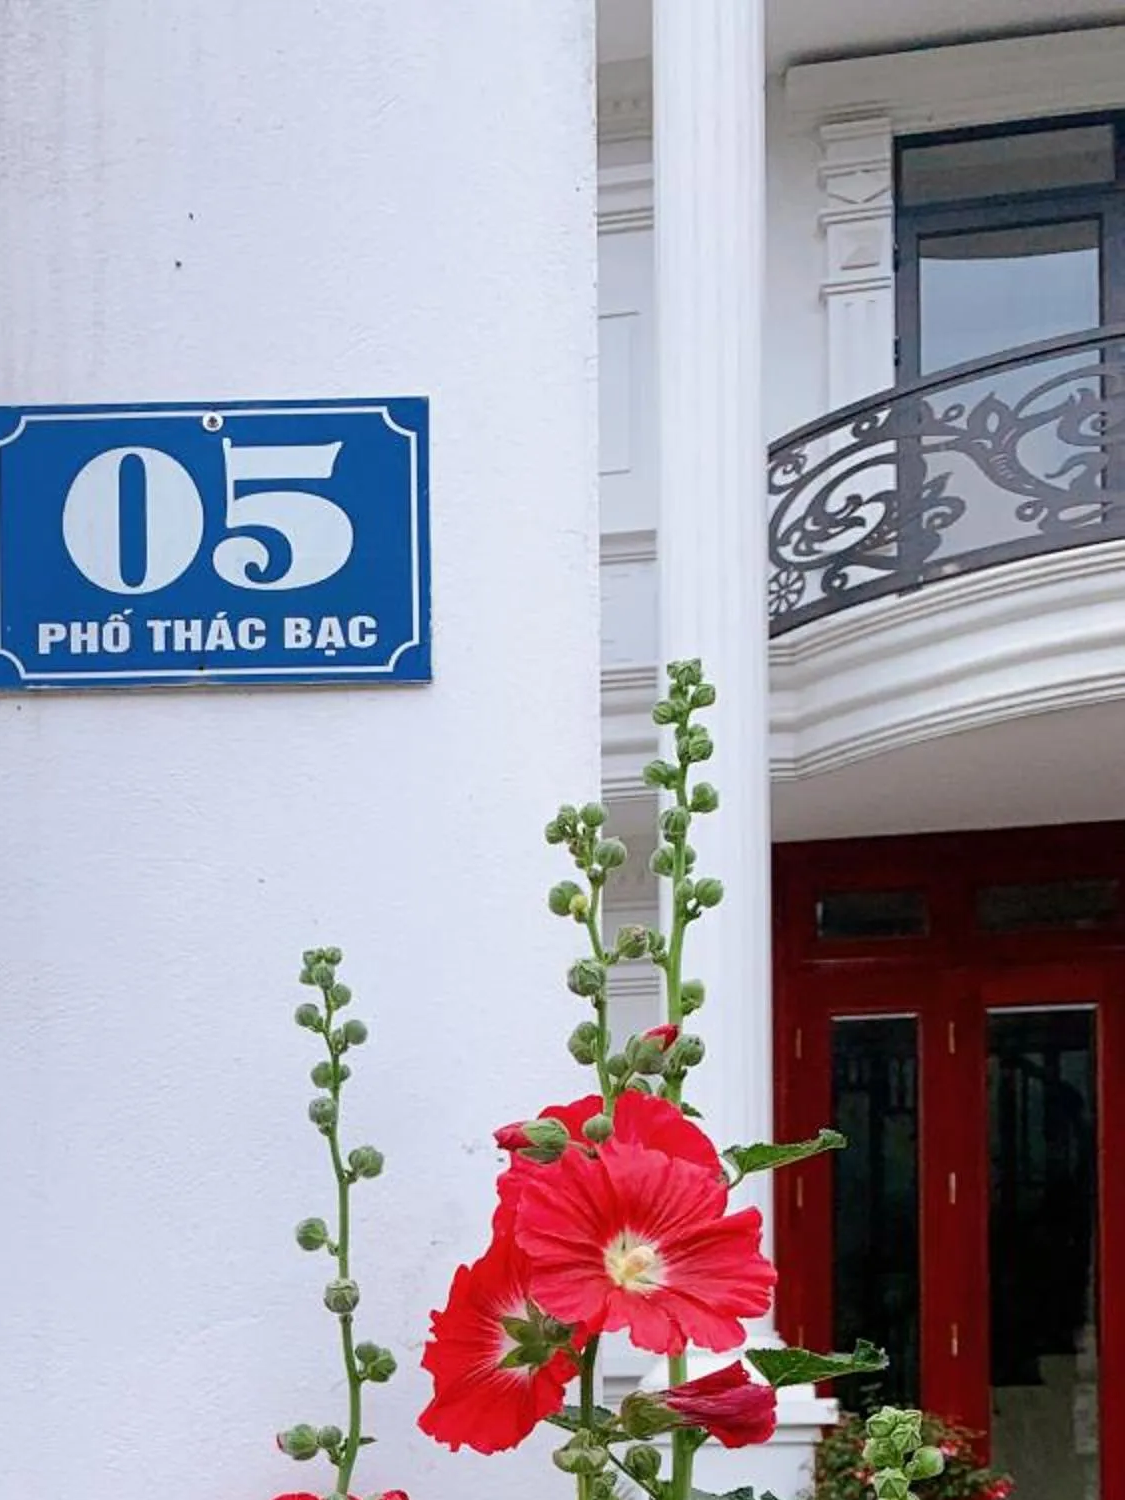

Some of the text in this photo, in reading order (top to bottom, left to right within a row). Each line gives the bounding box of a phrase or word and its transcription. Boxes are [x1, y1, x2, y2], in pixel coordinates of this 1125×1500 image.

[62, 437, 354, 594] 05
[37, 608, 378, 656] PHỐ THÁC BẠC
